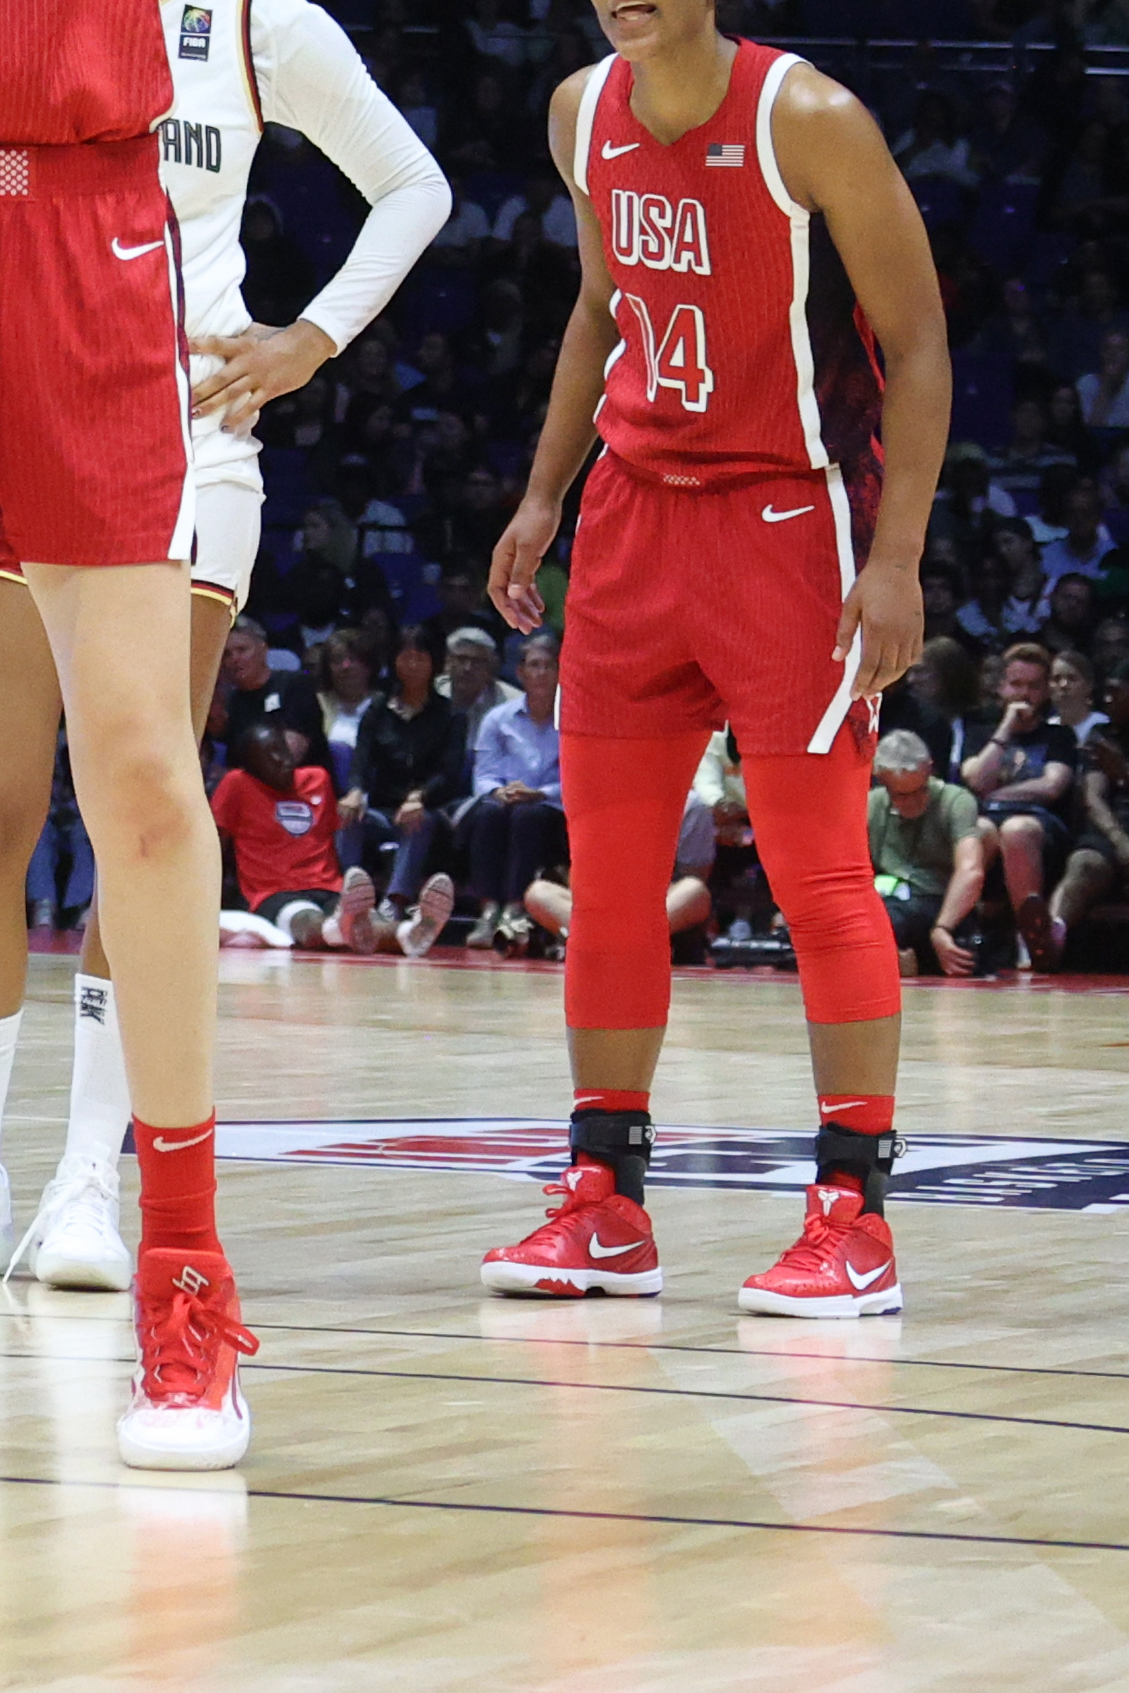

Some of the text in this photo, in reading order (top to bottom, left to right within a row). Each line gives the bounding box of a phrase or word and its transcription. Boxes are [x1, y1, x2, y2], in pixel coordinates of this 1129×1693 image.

[183, 36, 206, 48] FIBA
[611, 189, 712, 276] USA
[625, 293, 714, 413] 14
